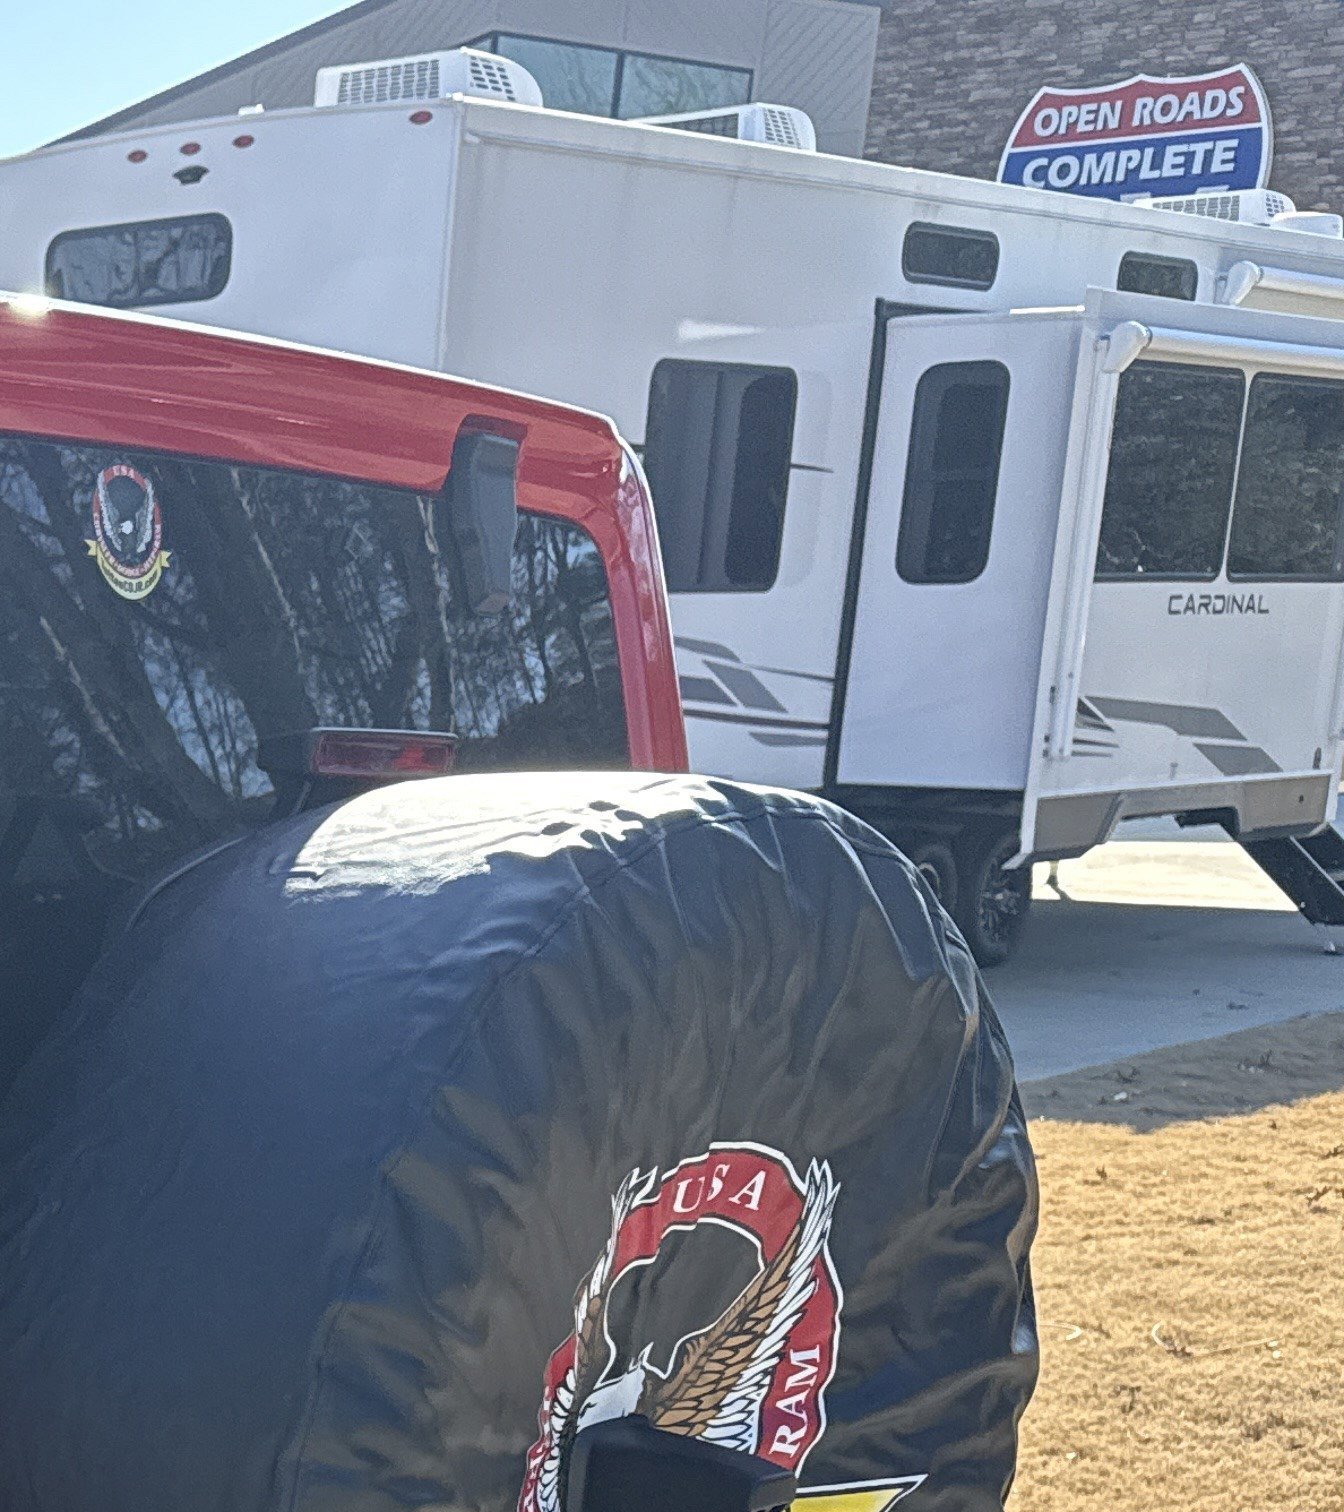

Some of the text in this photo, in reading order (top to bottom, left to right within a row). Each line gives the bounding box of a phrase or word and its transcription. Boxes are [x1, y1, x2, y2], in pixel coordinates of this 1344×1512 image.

[1034, 86, 1246, 138] OPEN ROADS
[1023, 138, 1240, 189] COMPLETE
[1167, 593, 1270, 616] CARDINAL
[673, 1163, 766, 1213] USA
[769, 1345, 820, 1459] RAM
